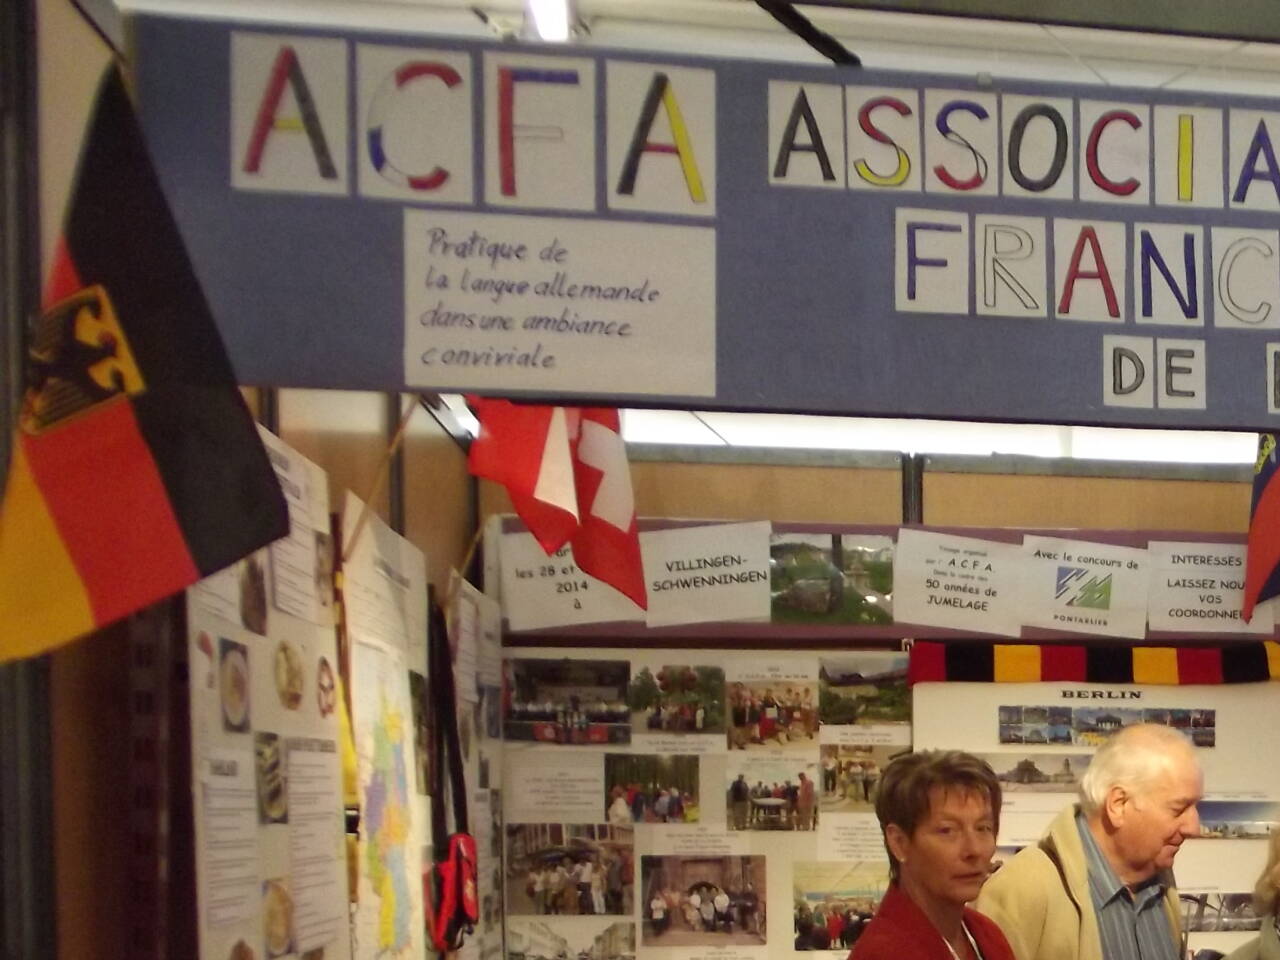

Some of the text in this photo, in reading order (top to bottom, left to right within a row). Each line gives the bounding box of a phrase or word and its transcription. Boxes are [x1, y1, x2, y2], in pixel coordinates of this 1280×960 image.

[242, 45, 706, 203] ACFA
[427, 227, 568, 269] Pratique de
[460, 268, 530, 303] langue
[533, 271, 660, 303] allemande
[420, 301, 634, 337] dans une ambiance
[420, 343, 556, 369] conviviale
[1112, 345, 1196, 398] DE
[665, 555, 747, 573] VILLINGEN-
[1033, 549, 1139, 570] Avec le concours de
[1171, 554, 1243, 567] INTERESSES
[556, 580, 589, 594] 2014
[652, 570, 768, 592] SCHWENNINGEN
[925, 579, 998, 598] 50 années de
[1167, 578, 1246, 590] LAISSEZ NOU
[926, 594, 989, 612] JUMELAGE
[1199, 594, 1223, 605] VOS
[1053, 614, 1108, 627] PONTARLIER
[1168, 607, 1253, 620] COORDONNE
[1061, 690, 1143, 700] BERLIN
